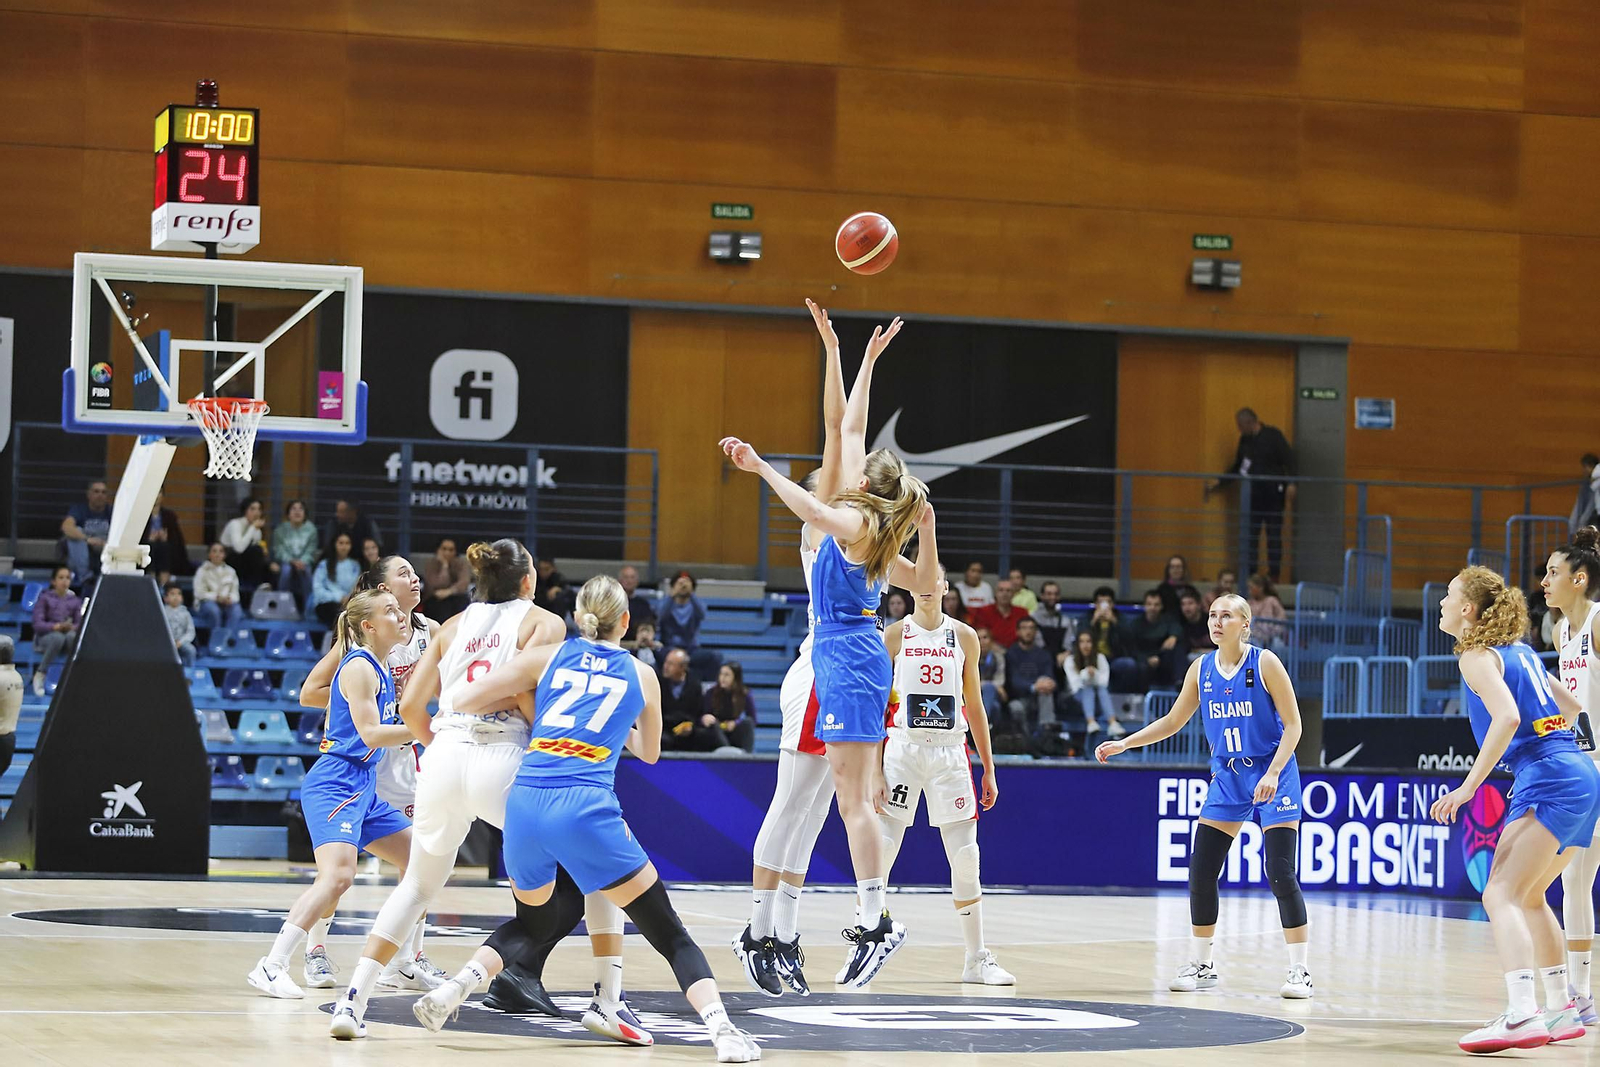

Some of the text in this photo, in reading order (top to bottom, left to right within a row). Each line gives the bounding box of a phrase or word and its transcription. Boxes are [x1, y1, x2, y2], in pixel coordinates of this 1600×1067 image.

[185, 112, 253, 142] 10:00
[179, 150, 247, 202] 24
[713, 204, 750, 217] SALIDA
[172, 208, 254, 240] renfe
[1194, 236, 1230, 249] SALIDA
[91, 386, 111, 399] FIBA
[454, 370, 493, 420] fi
[385, 452, 558, 489] fnetwork
[411, 492, 461, 507] FIBRA
[465, 494, 476, 508] Y
[580, 651, 609, 672] EVA
[904, 647, 955, 659] ESPAÑA
[919, 664, 944, 685] 33
[541, 668, 629, 733] 27
[1208, 699, 1254, 720] ÍSLAND
[912, 718, 950, 729] CaixaBank
[536, 739, 600, 760] DHL
[1224, 727, 1243, 753] 11
[892, 784, 909, 804] fi
[1158, 778, 1450, 821] FIB OMEN'
[89, 821, 155, 839] CaixaBank
[1156, 818, 1450, 889] ERBASKET
